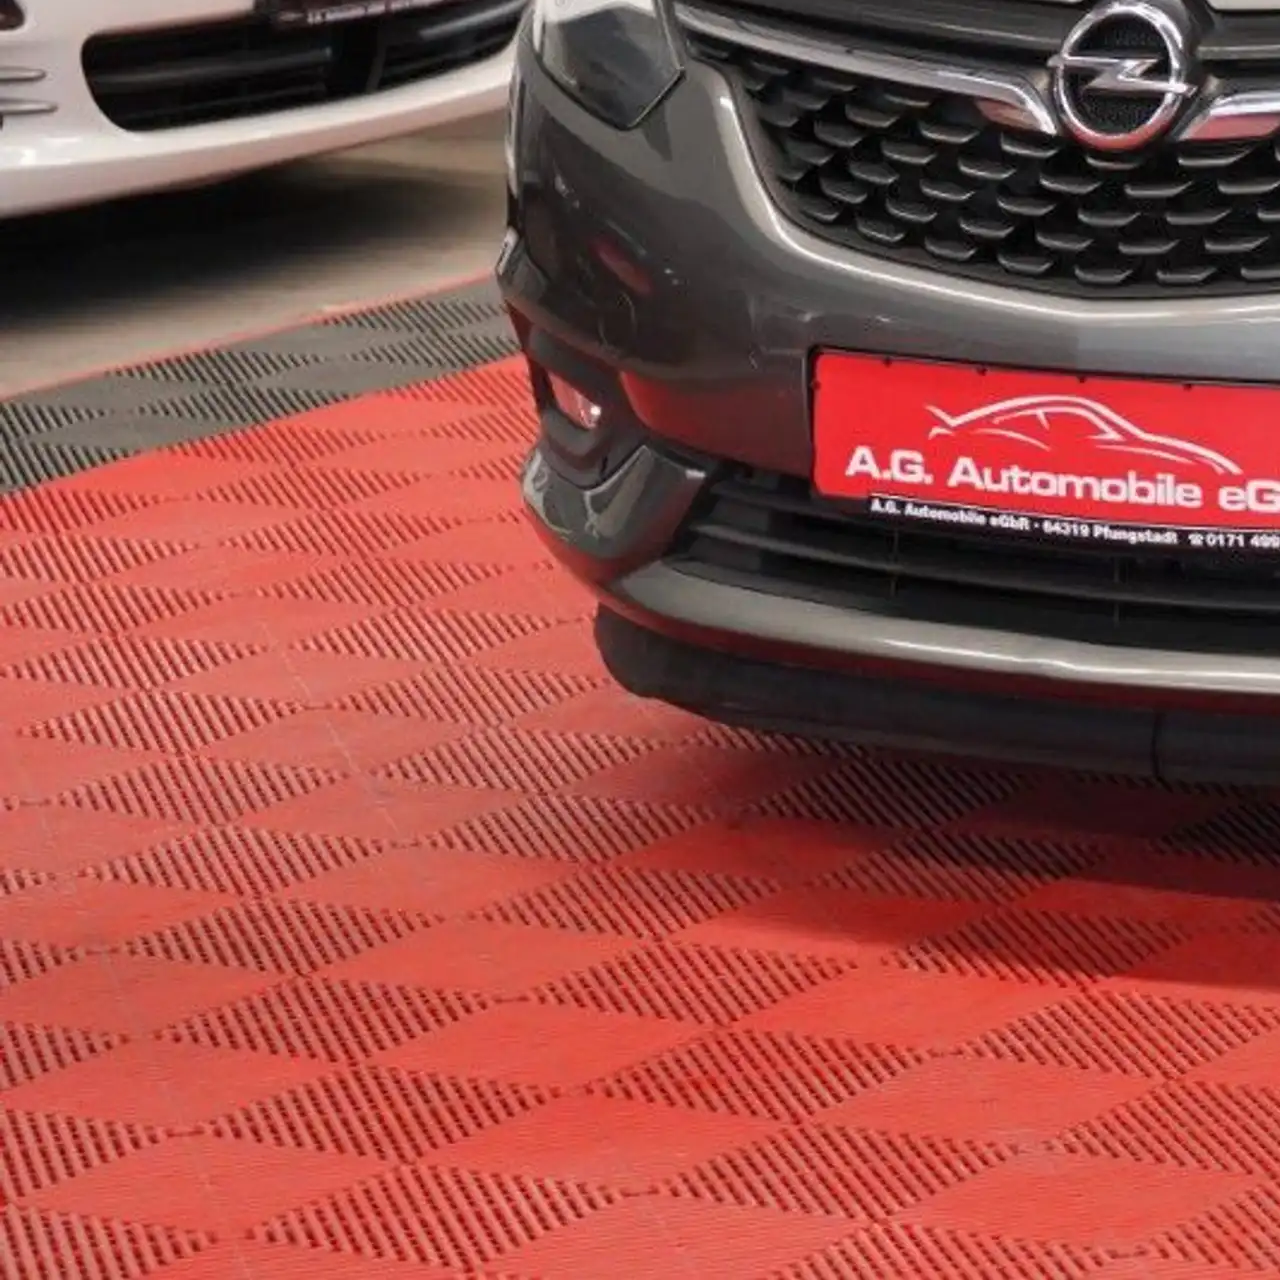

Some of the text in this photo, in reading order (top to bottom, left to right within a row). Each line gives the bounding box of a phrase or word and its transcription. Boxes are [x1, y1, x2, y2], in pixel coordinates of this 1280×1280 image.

[846, 445, 934, 485] A.G.
[947, 456, 1203, 508] Automobile
[870, 498, 899, 514] A.G.
[904, 504, 986, 525] Automobile
[989, 515, 1030, 531] eGbR
[1042, 520, 1090, 537] 64319
[1093, 524, 1178, 545] Pfungstadt
[1207, 532, 1245, 548] 0171
